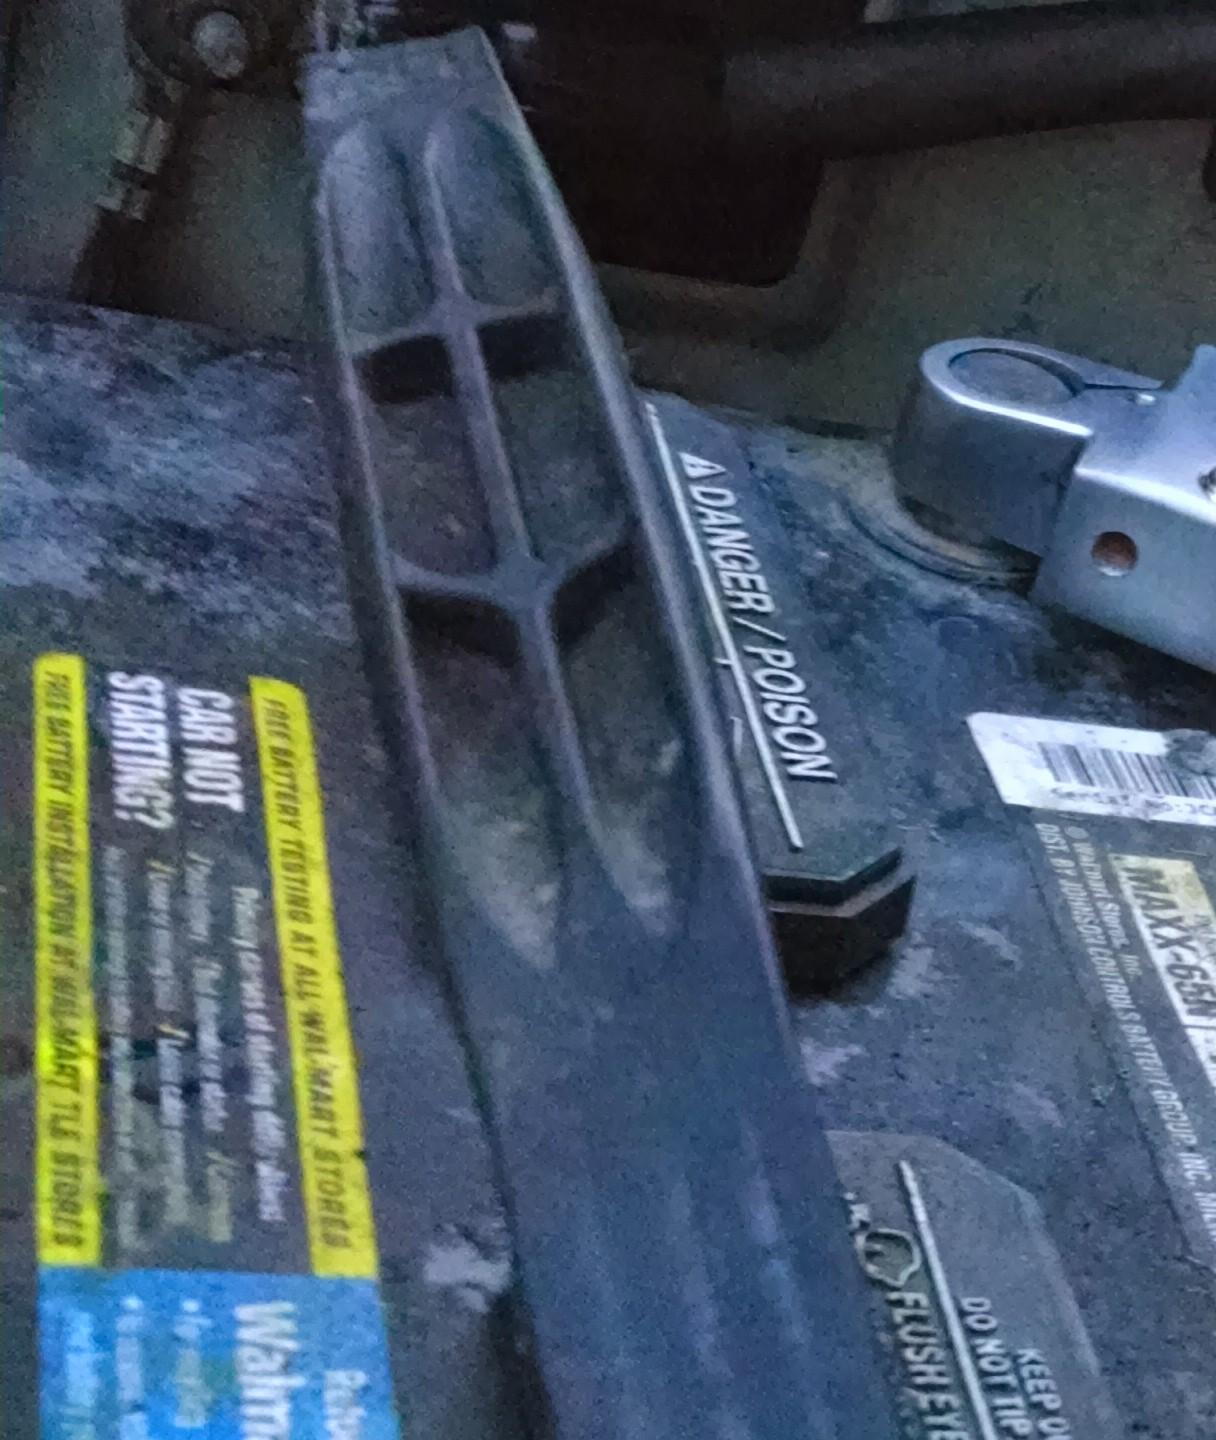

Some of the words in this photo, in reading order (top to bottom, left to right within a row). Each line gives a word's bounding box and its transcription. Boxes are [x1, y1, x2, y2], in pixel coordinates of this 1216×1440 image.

[687, 478, 776, 620] DANGER
[740, 641, 838, 781] POISON
[177, 686, 237, 745] CAR
[262, 697, 292, 740] FREE
[43, 715, 74, 795] BATTERY
[105, 670, 174, 829] STARTING?
[182, 747, 245, 812] NOT
[267, 745, 303, 830] BATTERY
[1032, 822, 1070, 854] DIST.
[1047, 857, 1079, 875] BY
[277, 838, 314, 924] TESTING
[1056, 878, 1110, 944] JOHNSON
[287, 930, 318, 957] AT
[290, 962, 323, 1001] ALL
[1086, 947, 1143, 1021] CONTROLS
[1120, 1024, 1172, 1085] BATTERY
[49, 1150, 84, 1246] STORES
[311, 1146, 353, 1249] STORES
[883, 1286, 952, 1387] FLUSH
[956, 1293, 1001, 1334] DO
[970, 1334, 1020, 1388] NOT
[1010, 1345, 1064, 1411] KEEP
